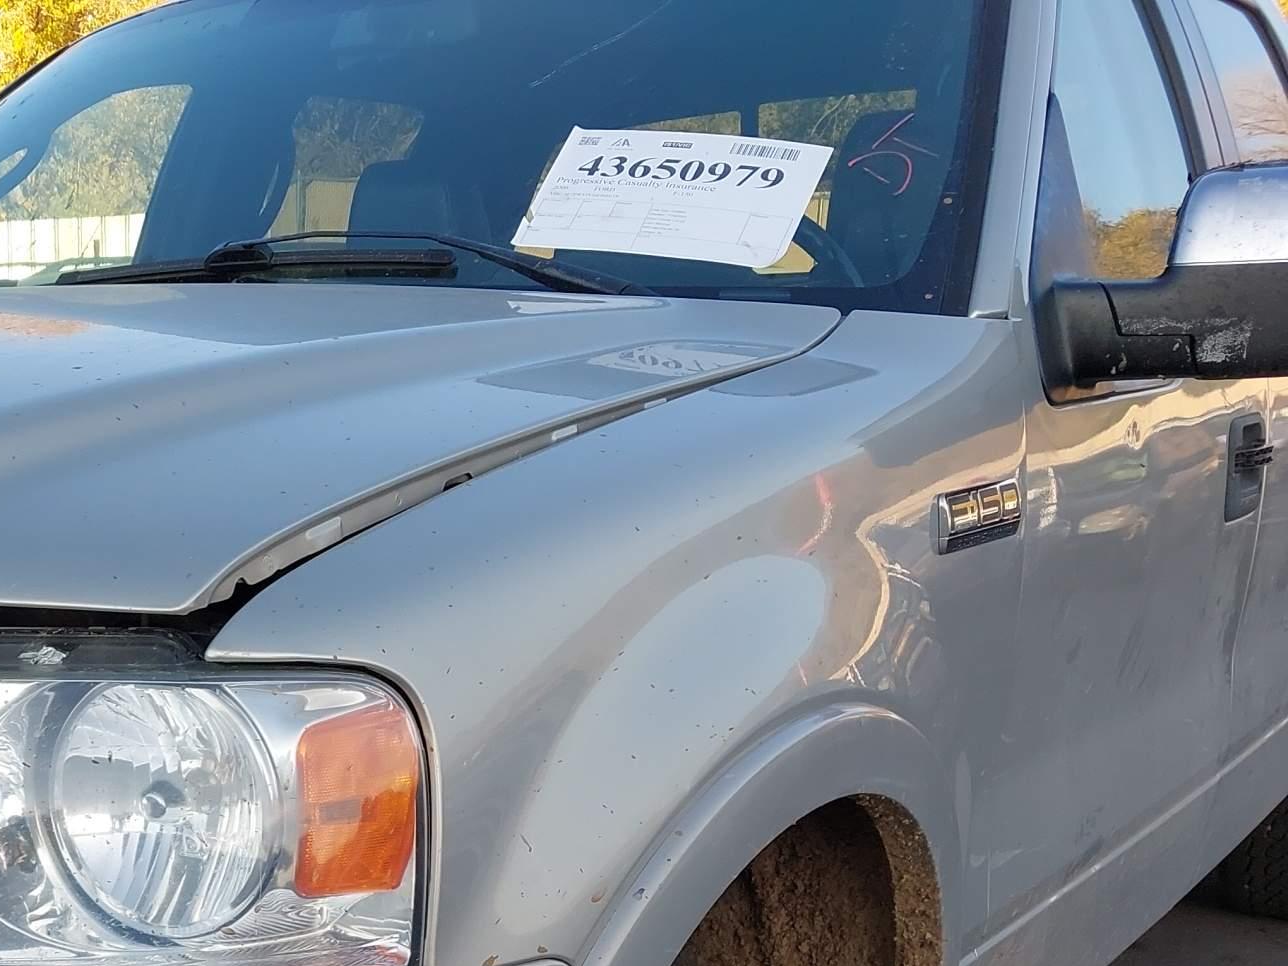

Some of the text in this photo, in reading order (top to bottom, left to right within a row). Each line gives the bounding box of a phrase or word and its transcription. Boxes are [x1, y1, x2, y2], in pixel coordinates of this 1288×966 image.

[556, 176, 717, 192] Progressive Casualty Insurance
[577, 155, 785, 189] 43650979
